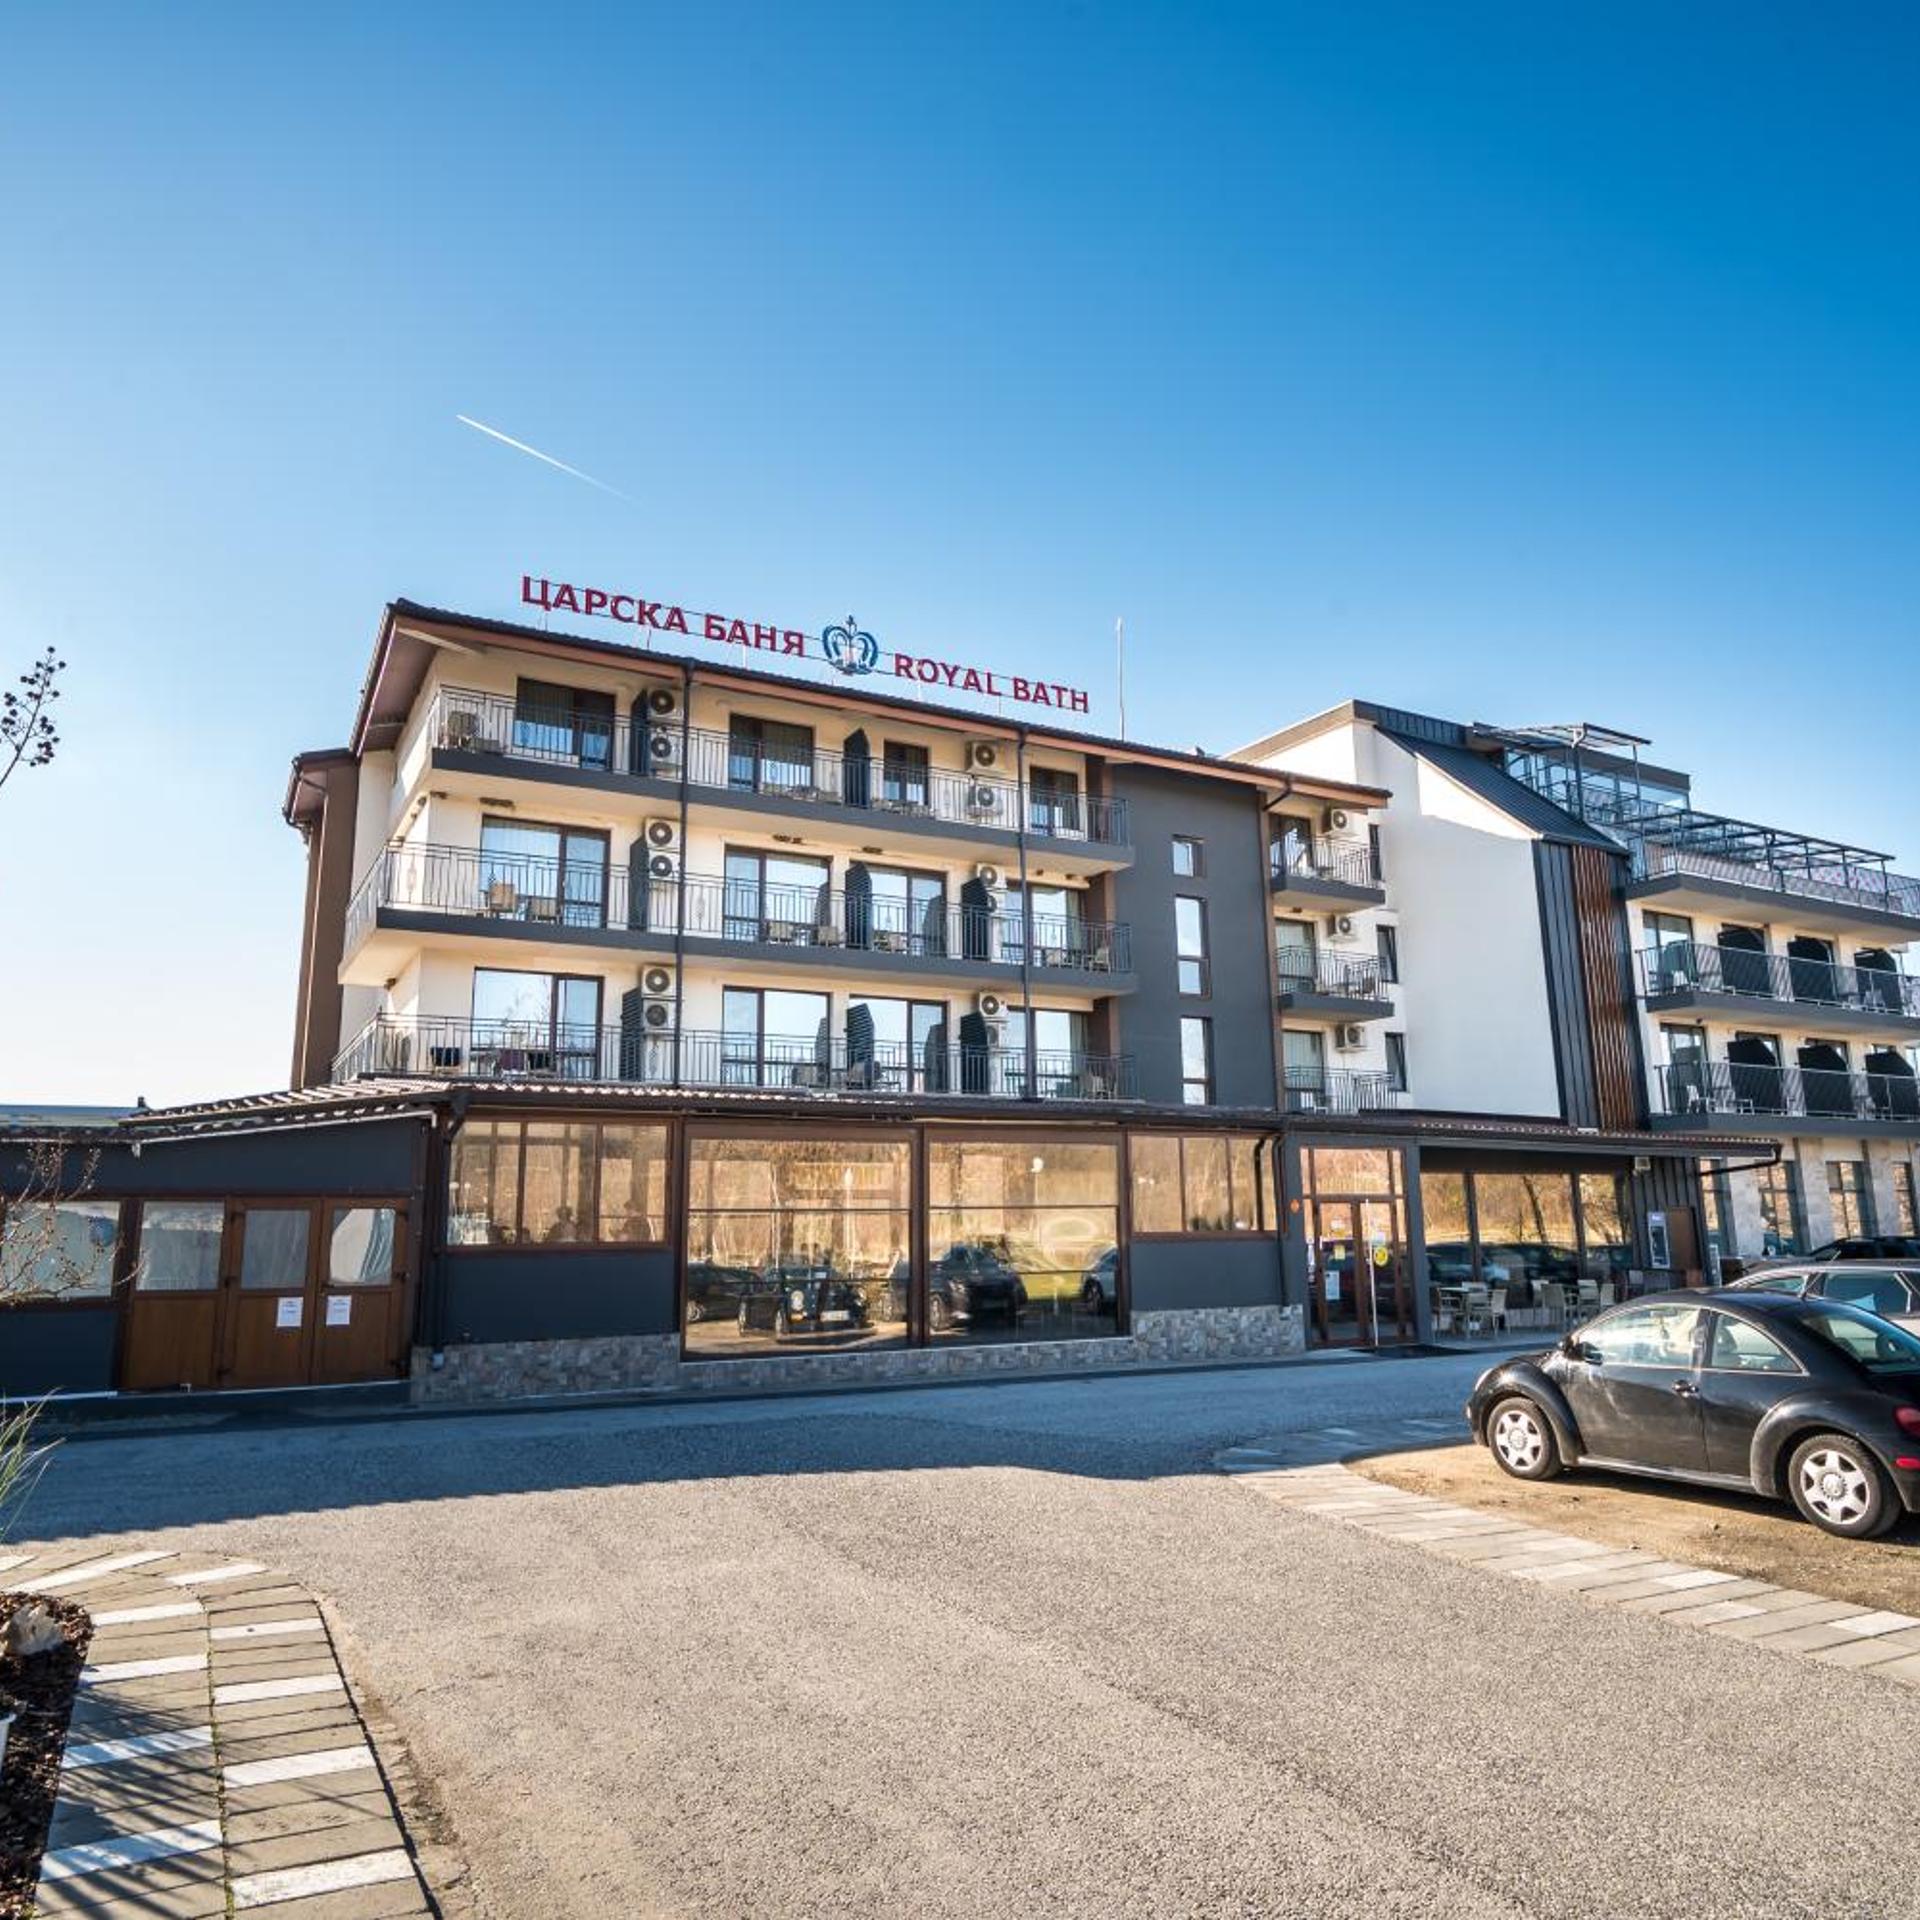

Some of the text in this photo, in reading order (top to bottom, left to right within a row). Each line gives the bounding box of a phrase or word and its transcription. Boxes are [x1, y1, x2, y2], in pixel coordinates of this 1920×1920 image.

[522, 576, 805, 657] ЦАРСКА БАНЯ
[895, 653, 1090, 713] ROYAL BATH
